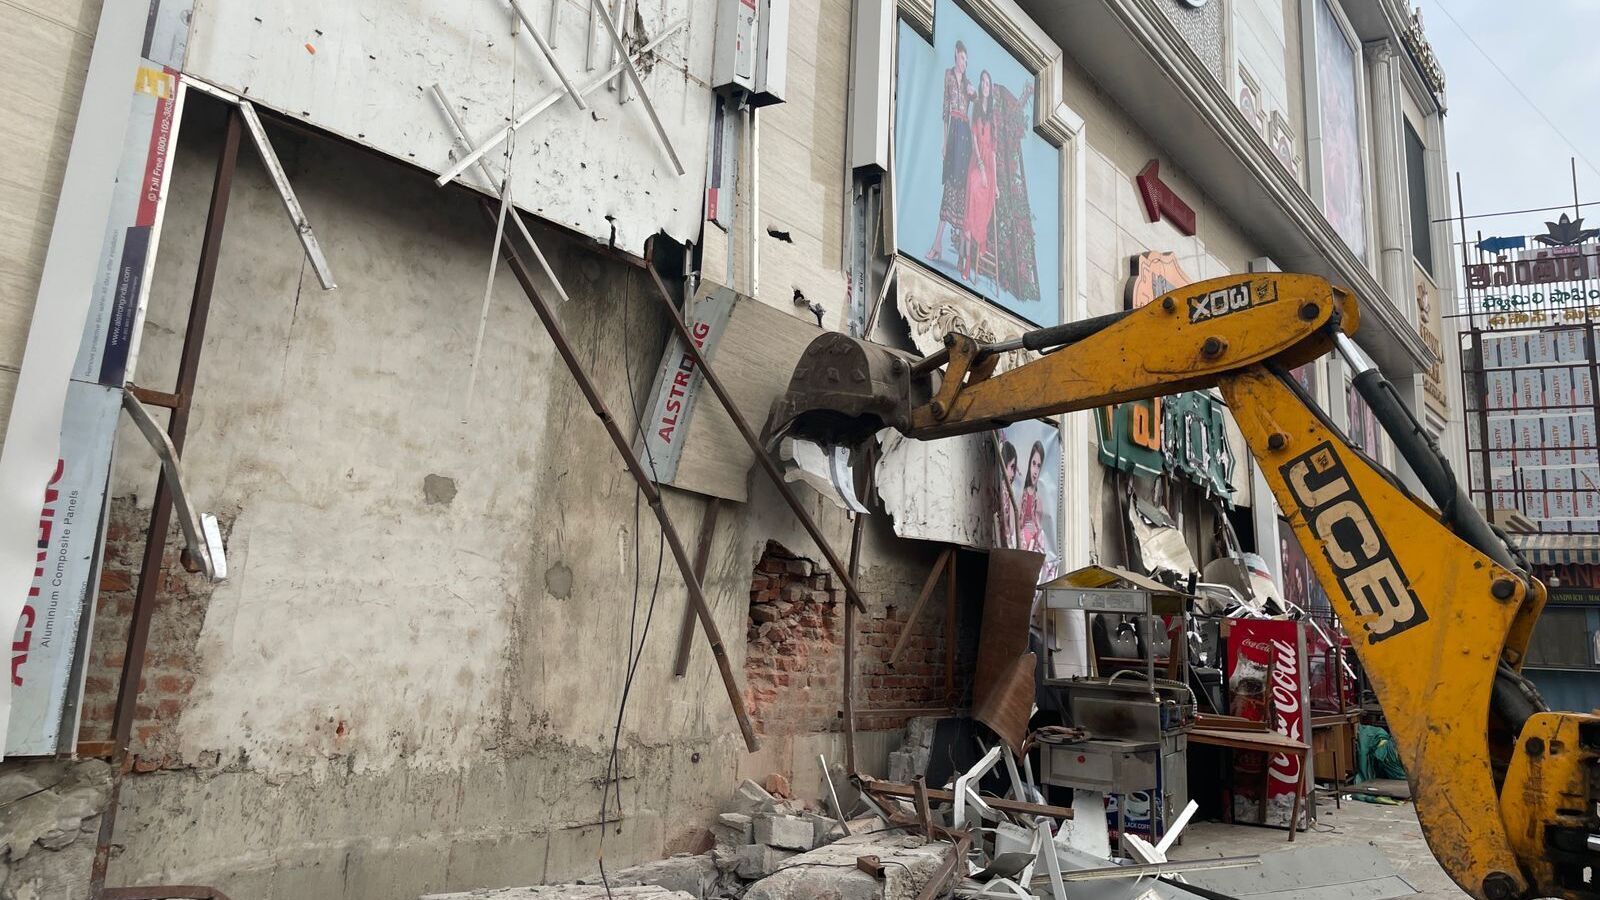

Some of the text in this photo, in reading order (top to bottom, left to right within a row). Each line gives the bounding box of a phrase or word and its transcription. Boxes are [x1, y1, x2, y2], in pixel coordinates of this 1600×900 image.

[152, 156, 164, 176] Free
[1192, 285, 1250, 323] 3DX
[1496, 479, 1504, 509] ALSRONG
[1525, 478, 1534, 510] ALSRONG
[1289, 460, 1416, 634] JCB
[41, 489, 79, 648] Aluminium Composite Panels
[1551, 594, 1583, 602] SANDWICH
[1268, 638, 1299, 784] Coa-Cola
